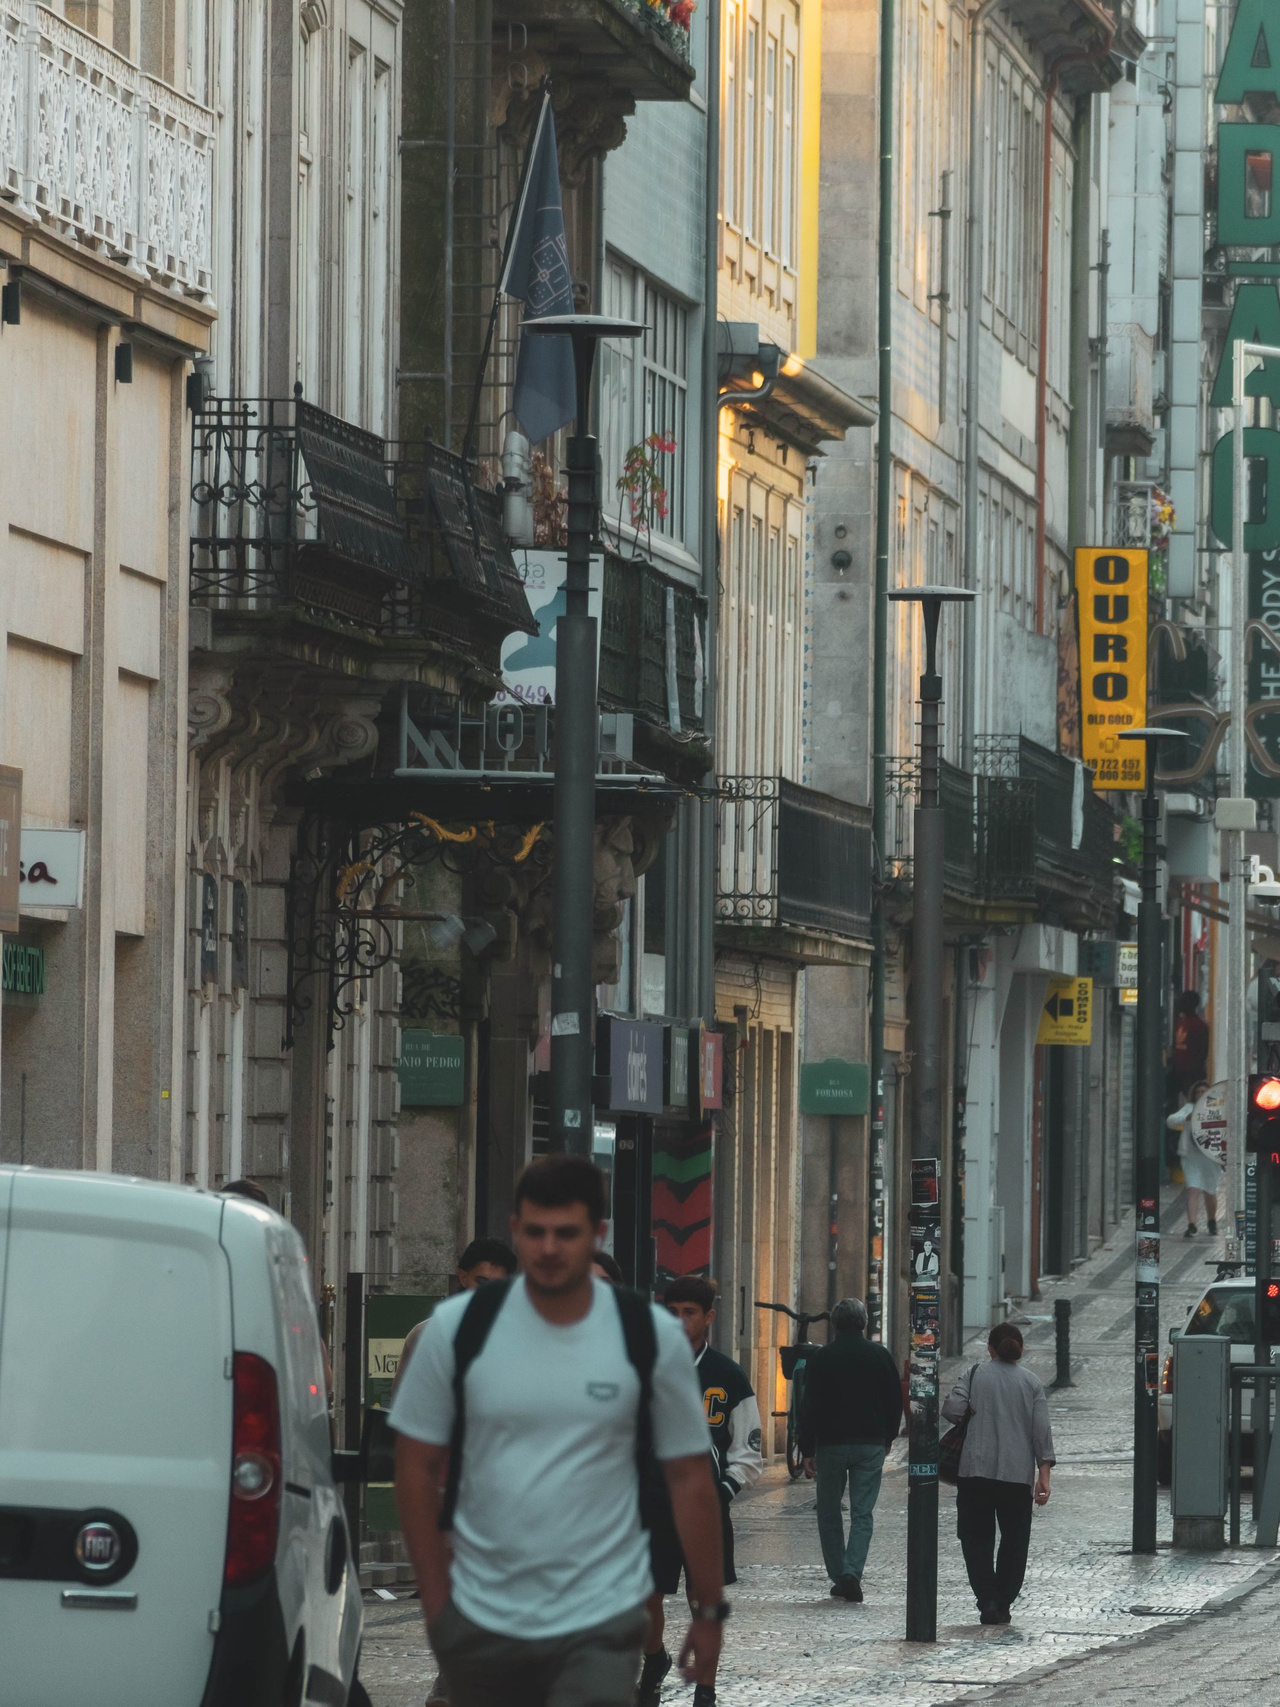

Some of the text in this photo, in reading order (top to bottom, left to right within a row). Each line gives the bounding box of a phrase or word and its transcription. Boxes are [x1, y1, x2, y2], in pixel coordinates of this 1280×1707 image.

[1093, 556, 1129, 702] OURO
[1087, 714, 1132, 725] OLD GOLD
[1086, 759, 1140, 770] 19 722 457
[1099, 770, 1118, 781] 000
[1077, 982, 1089, 1024] COMPRO
[397, 1056, 460, 1068] ONIO PEDRO
[816, 1088, 853, 1098] FORMOSA
[703, 1387, 728, 1427] C
[85, 1536, 112, 1559] FIAT
